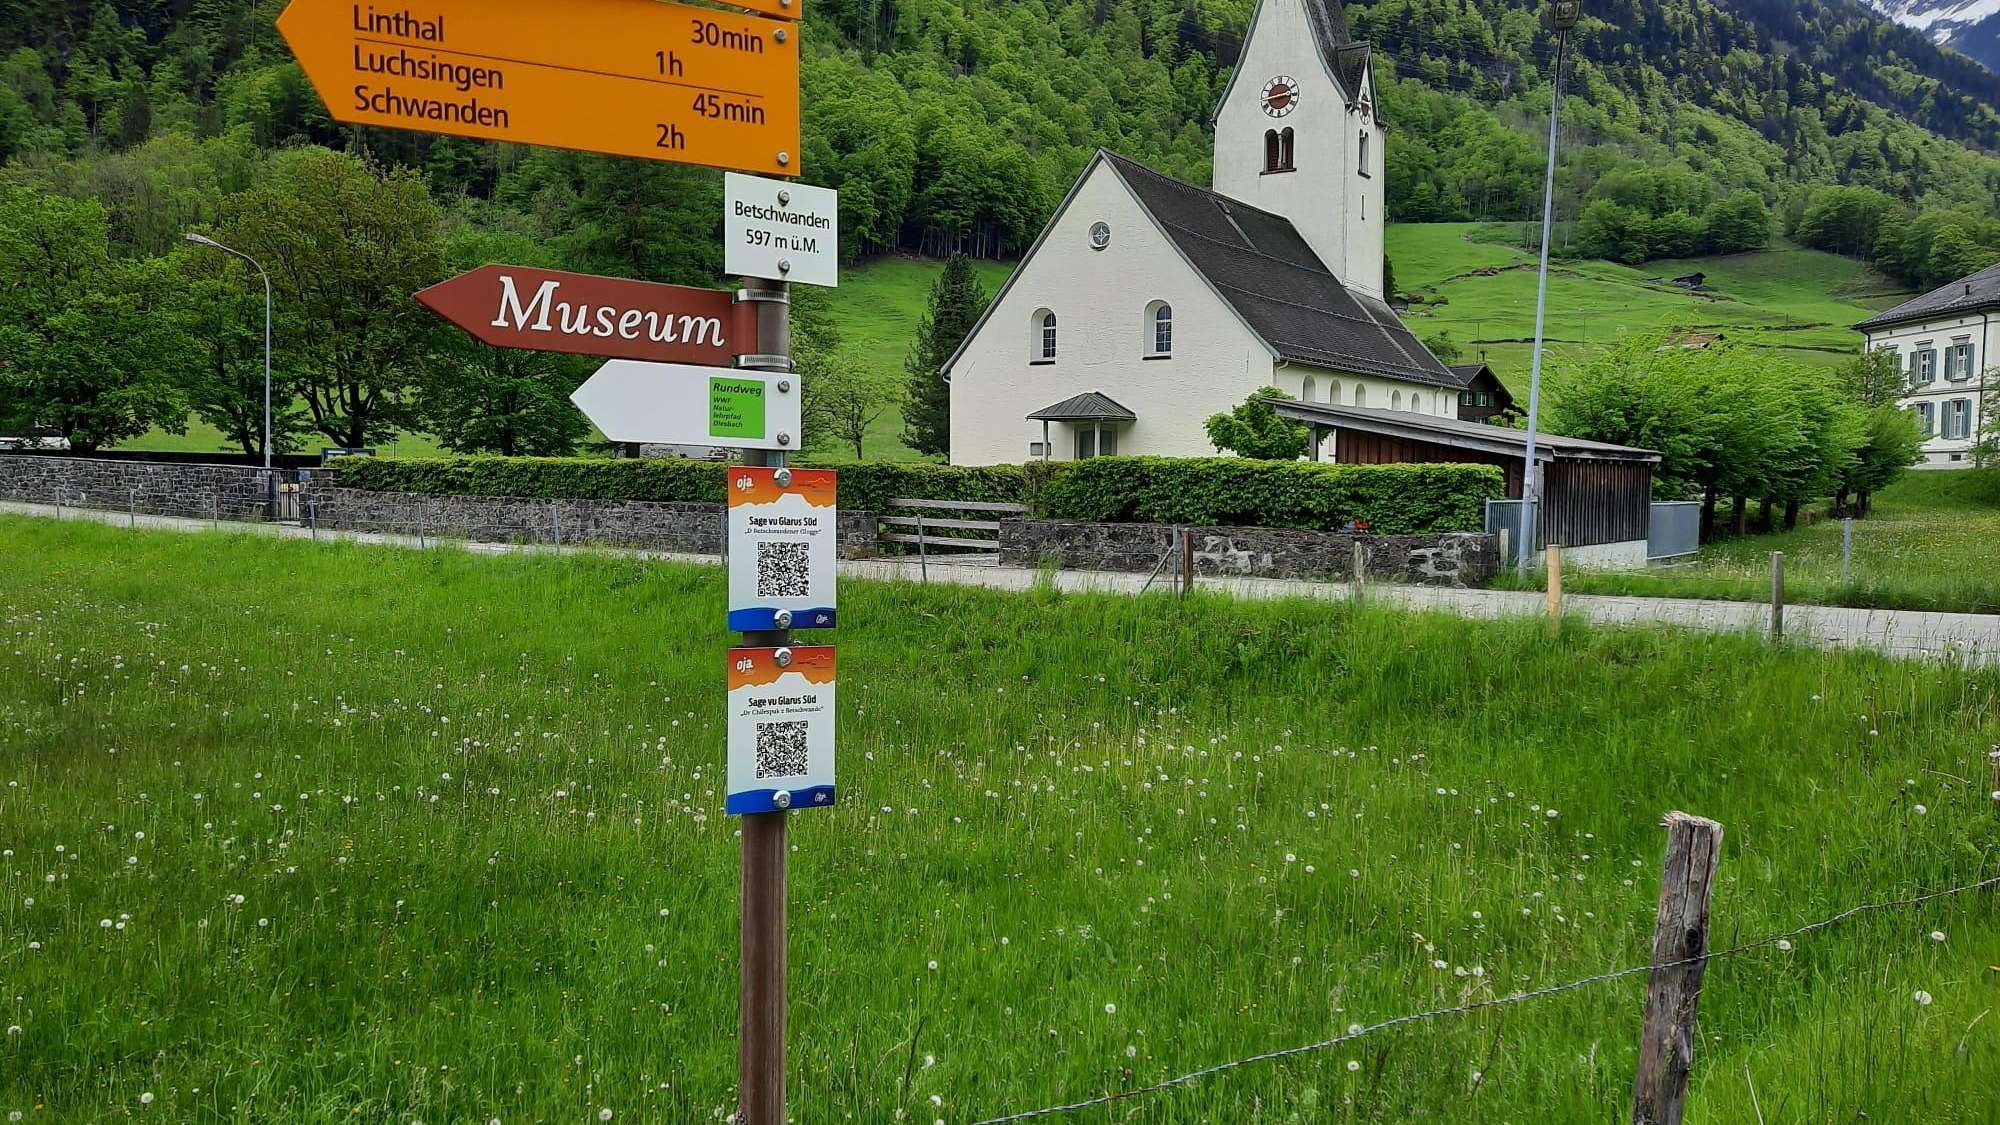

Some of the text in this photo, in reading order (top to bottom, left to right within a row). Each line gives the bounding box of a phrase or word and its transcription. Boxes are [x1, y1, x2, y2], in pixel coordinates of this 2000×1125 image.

[353, 4, 445, 42] Linthal
[354, 44, 504, 92] Luchsingen
[354, 84, 509, 128] Schwanden
[734, 200, 830, 229] Betschwanden
[746, 228, 820, 254] 597 m ü.M.
[490, 275, 725, 347] Museum
[713, 382, 762, 397] Rundweg
[748, 516, 767, 527] Sage
[779, 516, 802, 526] Glarus
[803, 516, 817, 526] Süd
[748, 695, 817, 708] Sage vu Glarus Süd
